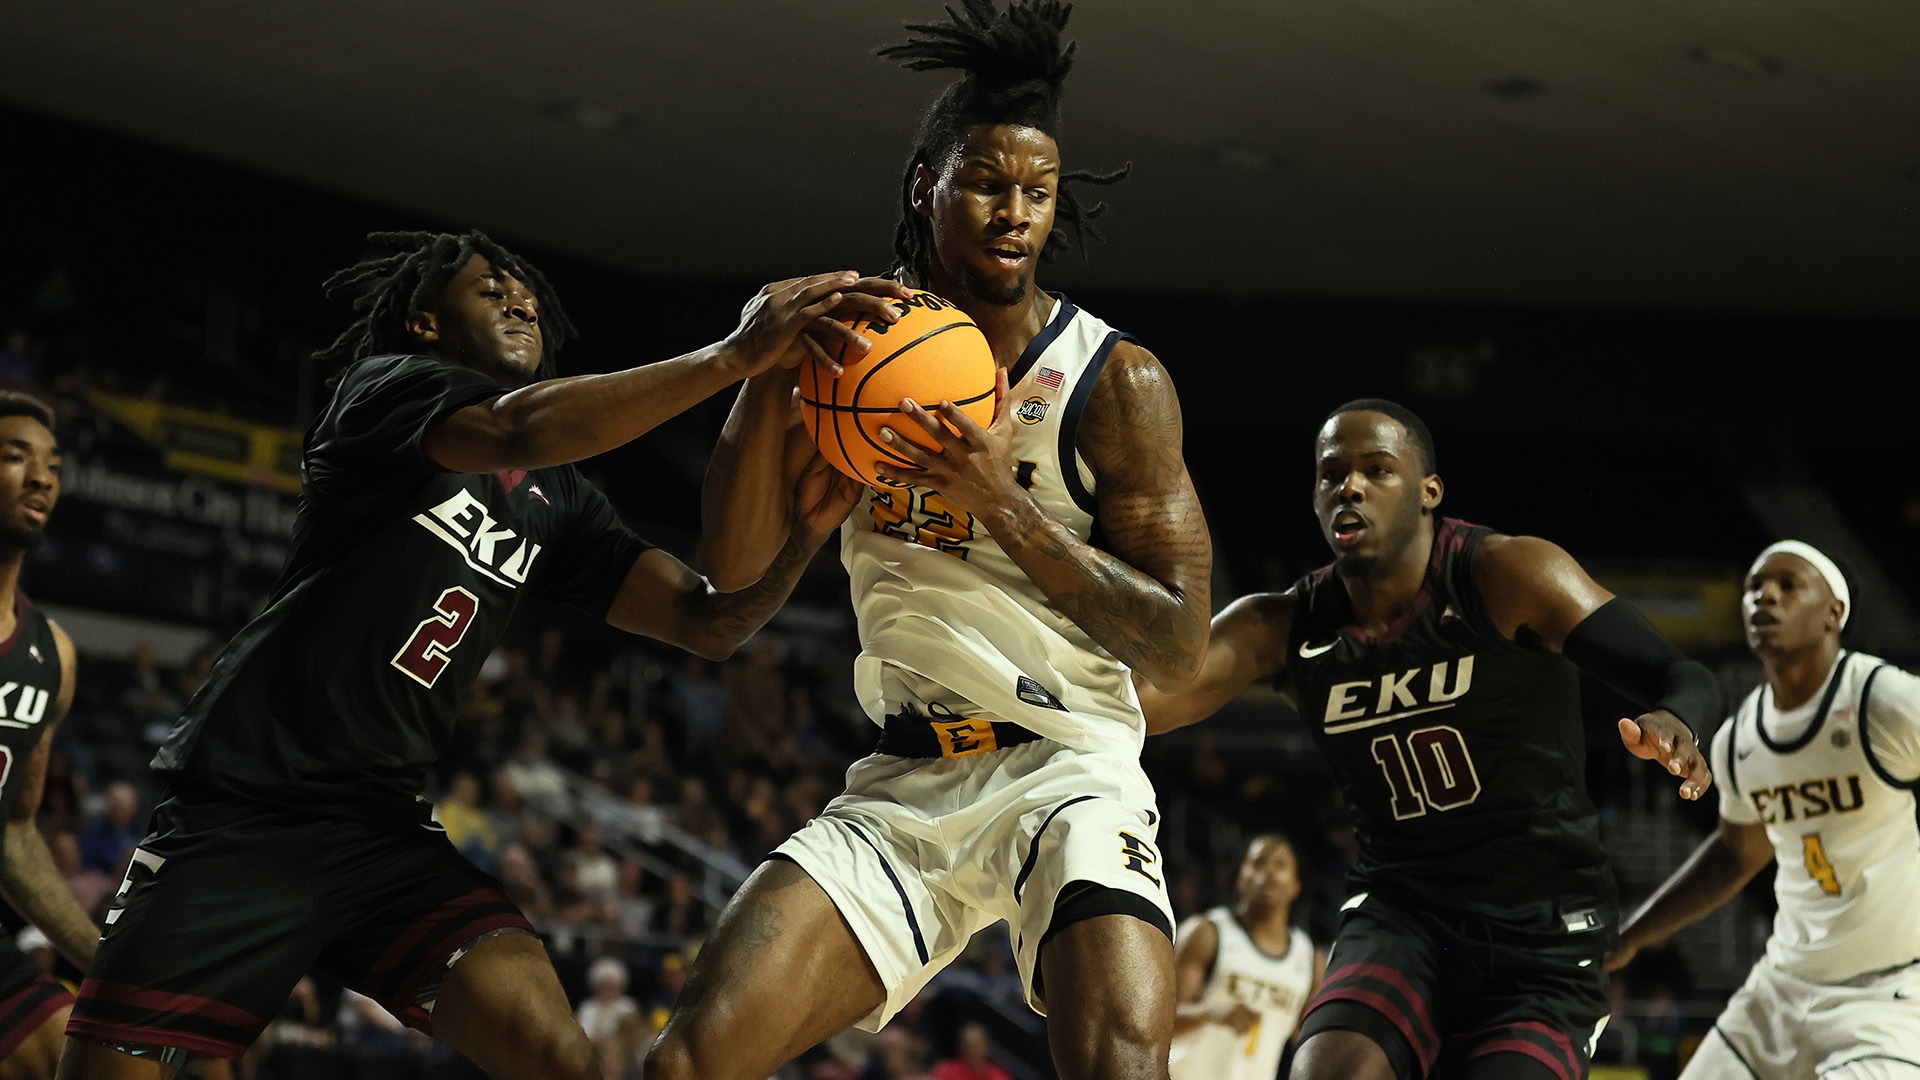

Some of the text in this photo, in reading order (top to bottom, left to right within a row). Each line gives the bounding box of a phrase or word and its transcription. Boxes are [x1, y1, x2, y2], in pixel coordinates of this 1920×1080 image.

[429, 488, 541, 584] EKU
[870, 485, 973, 561] 22
[390, 586, 479, 689] 2
[1324, 655, 1475, 723] EKU
[1371, 725, 1482, 821] 10
[1751, 776, 1864, 824] ETSU
[1803, 834, 1841, 896] 4
